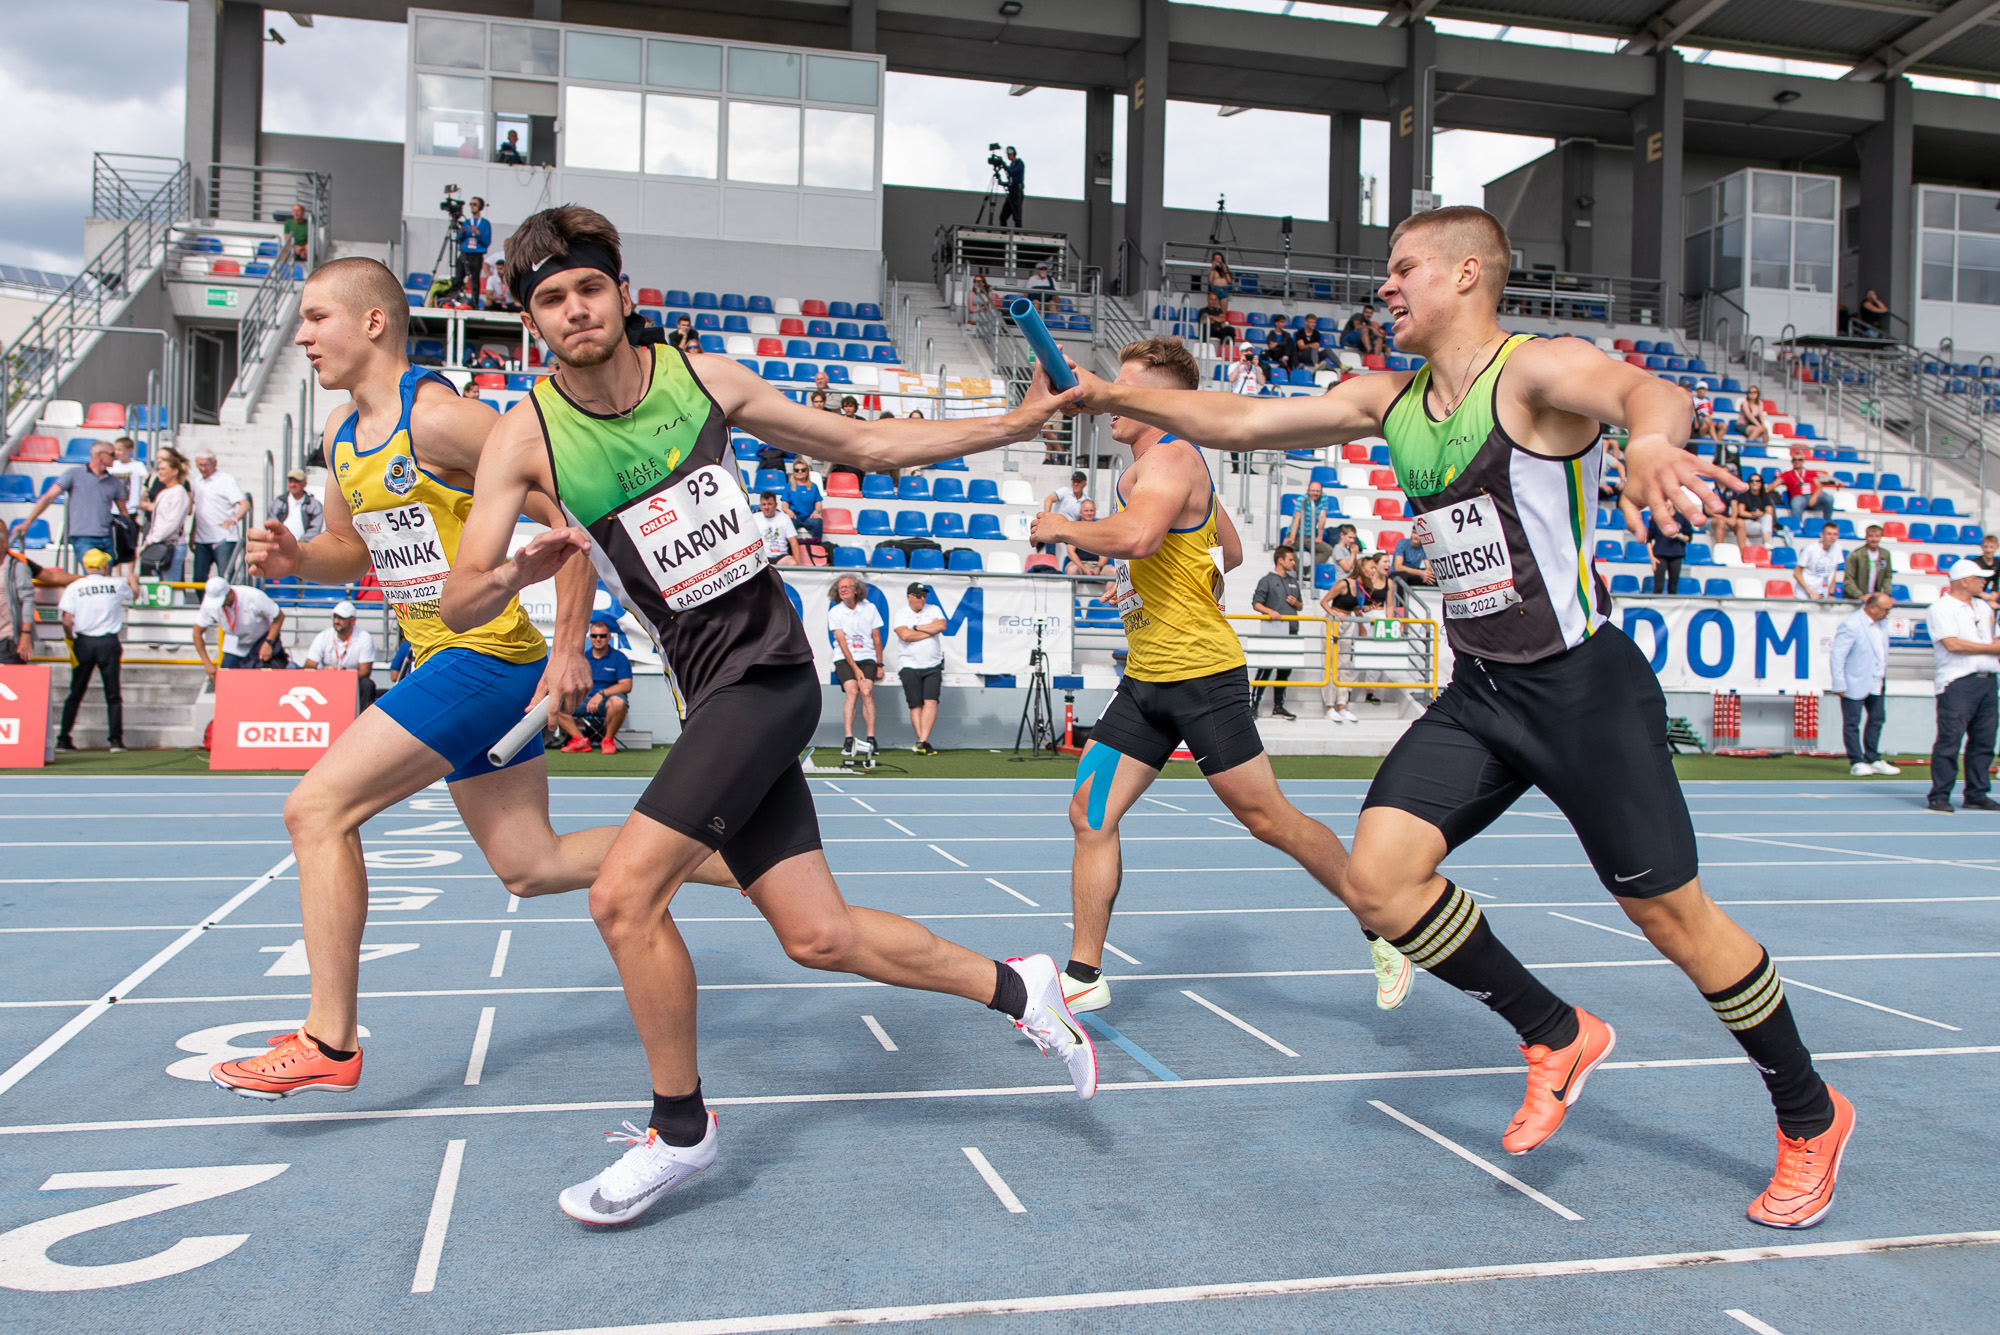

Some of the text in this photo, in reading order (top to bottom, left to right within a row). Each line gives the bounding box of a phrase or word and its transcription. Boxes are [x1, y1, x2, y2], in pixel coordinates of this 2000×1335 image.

[1135, 77, 1144, 110] E
[1400, 105, 1413, 138] E
[1647, 131, 1662, 163] E
[616, 457, 657, 483] BIAŁE
[622, 470, 663, 493] BŁOTA
[687, 471, 719, 505] 93
[385, 506, 425, 531] 545
[642, 513, 677, 534] ORLEN
[1451, 503, 1483, 533] 94
[653, 508, 740, 573] KAROW
[371, 540, 441, 570] ZIMNIAK
[1430, 541, 1505, 585] ĘDZIERSKI
[665, 585, 683, 597] PZLA
[723, 550, 747, 567] POLSKI
[747, 541, 762, 554] U20
[78, 584, 117, 597] SĘDZIA
[136, 585, 172, 606] A-9
[385, 585, 438, 600] RADOM 2022
[676, 564, 750, 608] RADOM 2022
[1476, 584, 1497, 594] POLSKI
[1470, 596, 1498, 613] 2022
[998, 615, 1060, 627] radm
[1027, 628, 1060, 636] pcyzji
[1375, 620, 1400, 639] A-8
[244, 727, 322, 742] ORLEN
[258, 939, 420, 976] 4
[0, 1163, 292, 1292] 2
